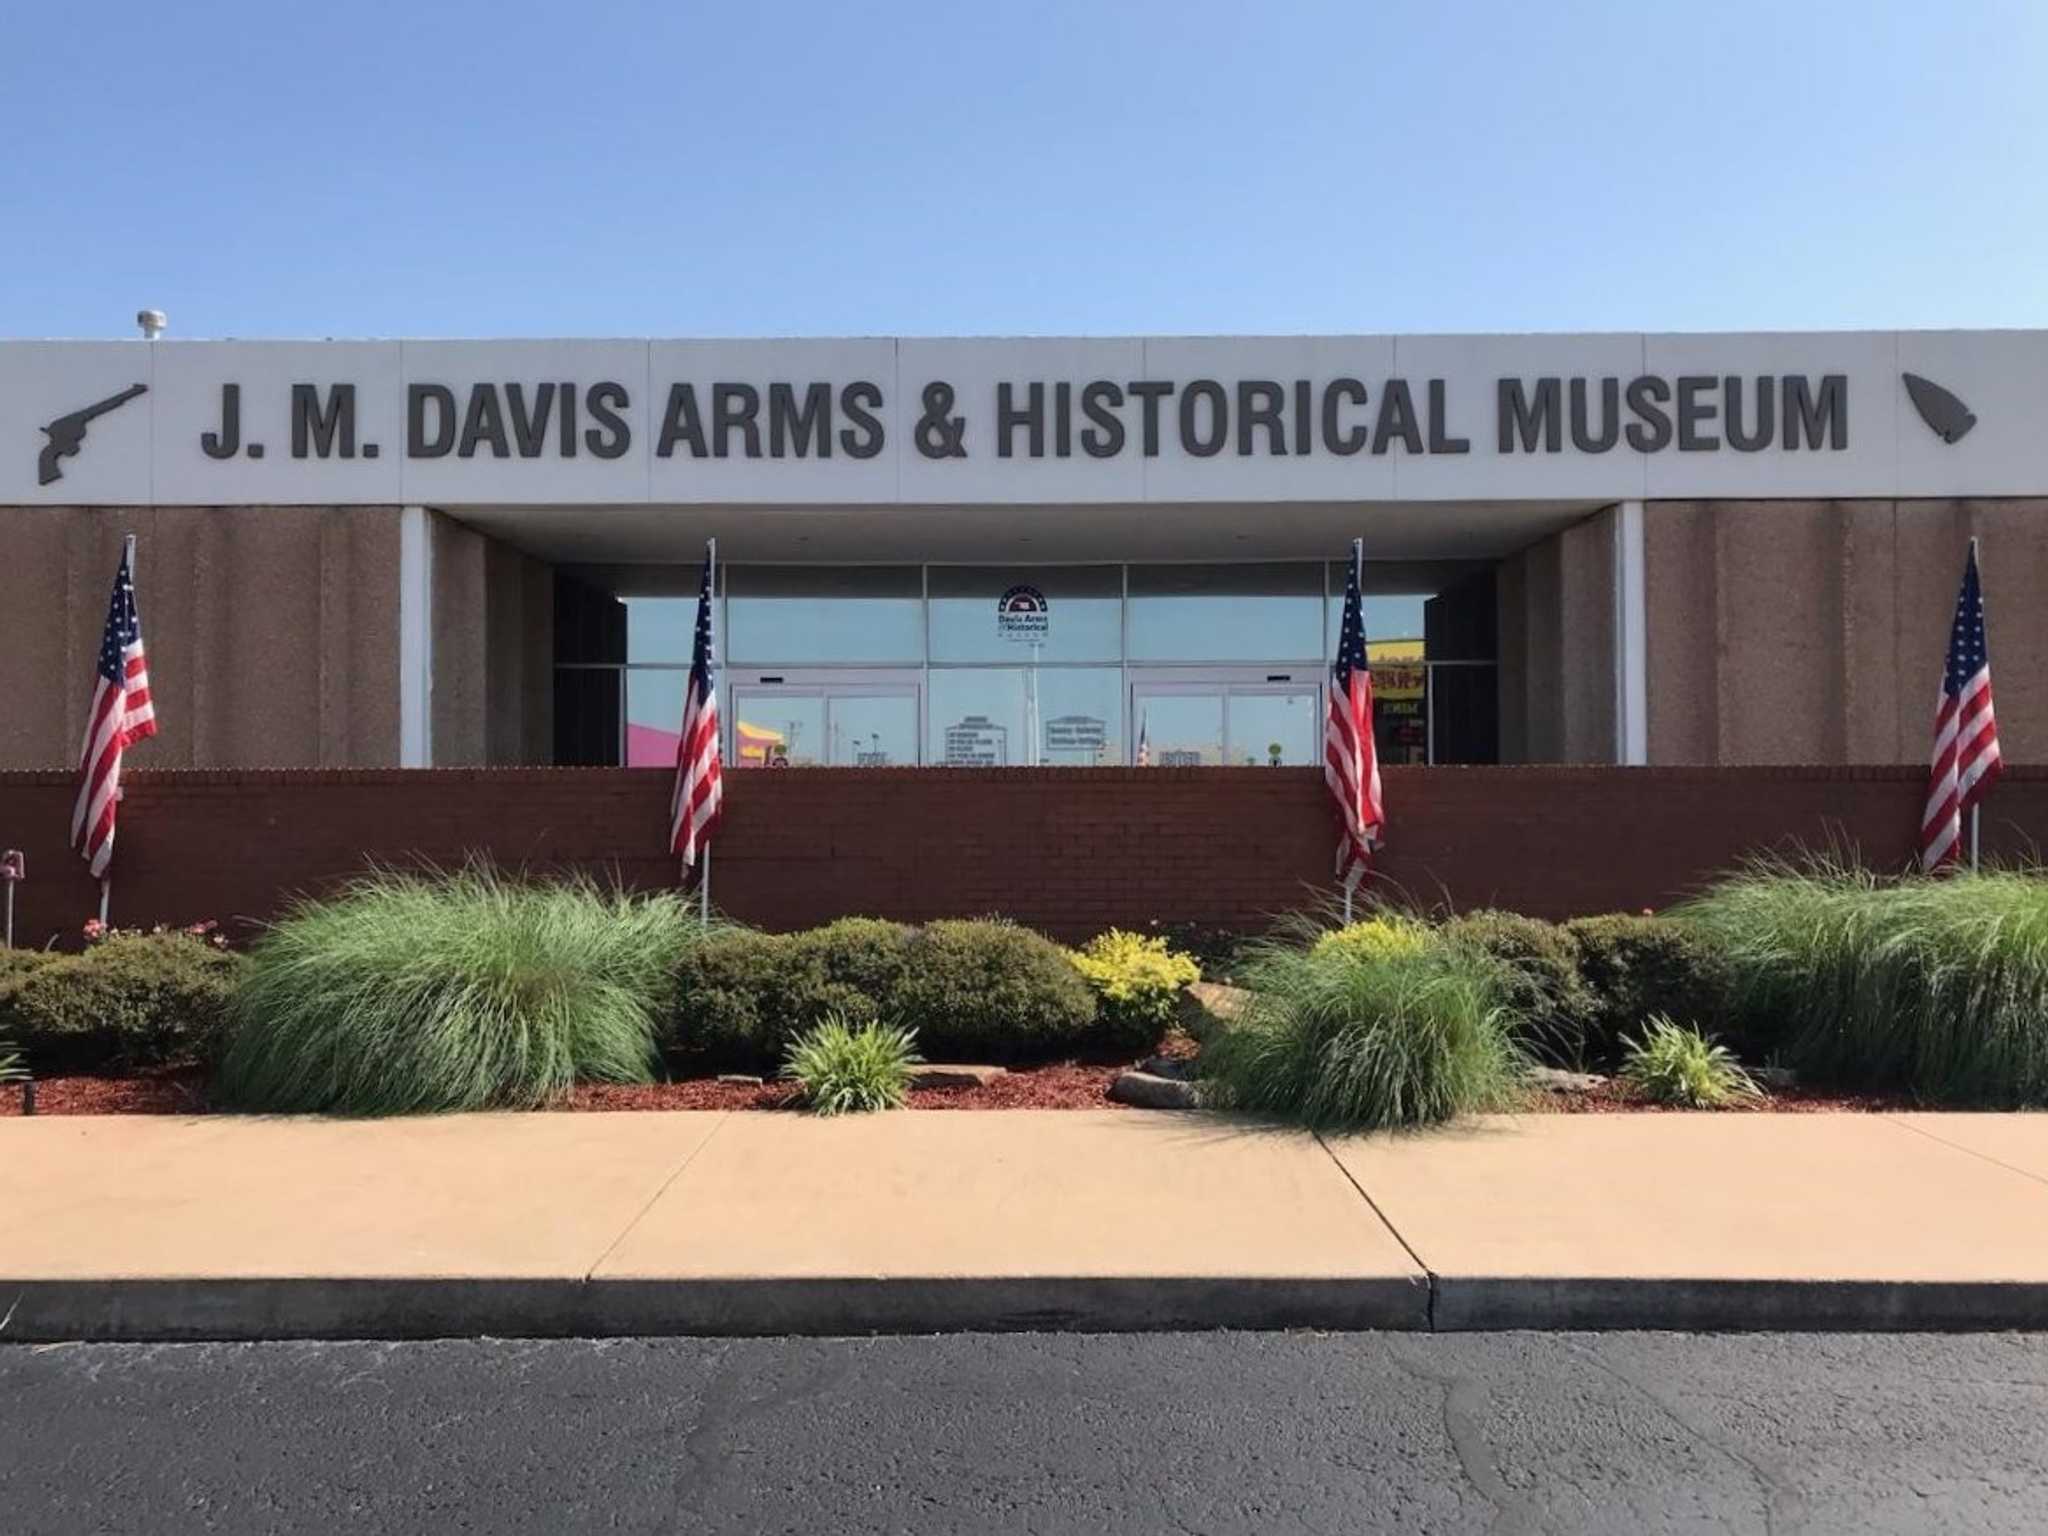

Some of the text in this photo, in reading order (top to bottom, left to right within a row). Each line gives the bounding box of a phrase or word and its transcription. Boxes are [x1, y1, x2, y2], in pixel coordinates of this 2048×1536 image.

[201, 373, 1849, 460] J. M. DAVIS ARMS & HISTORICAL MUSEUM
[1007, 622, 1049, 631] Historical
